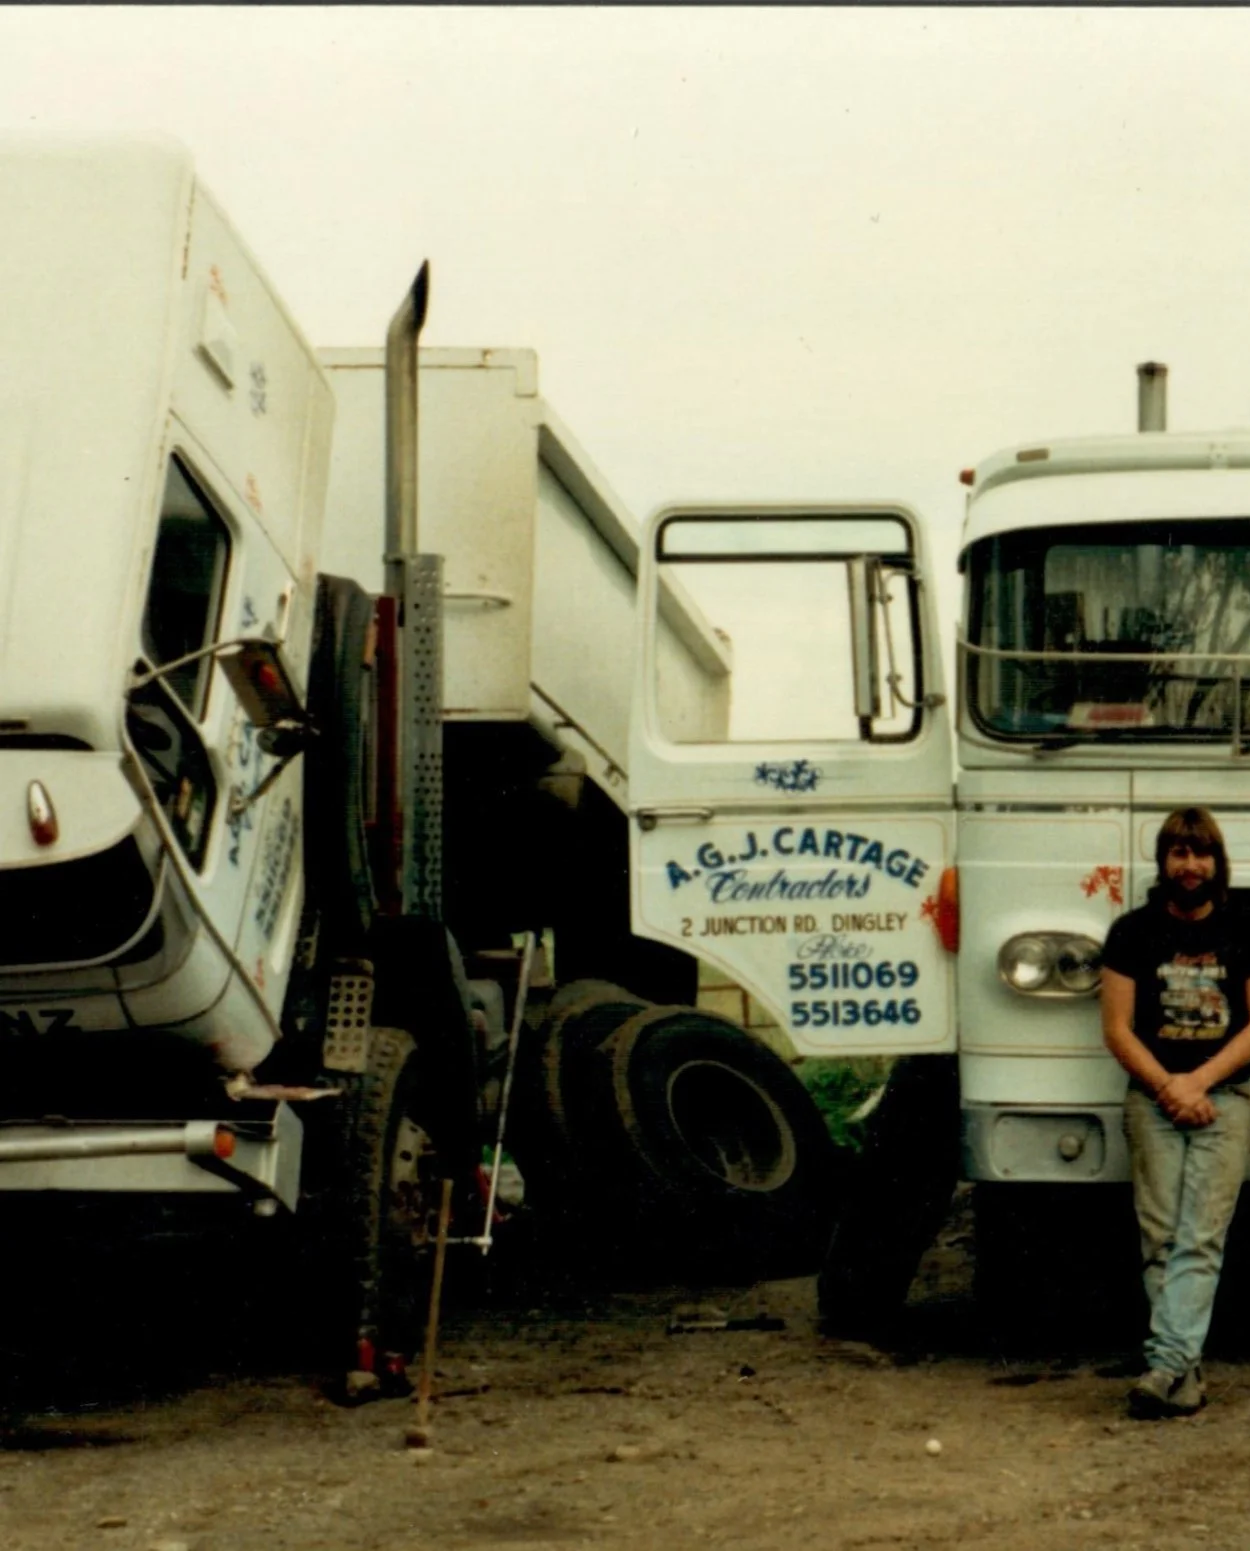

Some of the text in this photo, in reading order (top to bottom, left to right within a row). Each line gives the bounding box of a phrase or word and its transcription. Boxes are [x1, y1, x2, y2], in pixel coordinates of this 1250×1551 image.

[773, 827, 930, 888] CARTAGE
[706, 867, 871, 904] Contractors
[681, 918, 693, 937] 2
[700, 915, 787, 936] JUNCTION
[832, 912, 907, 932] DINGLEY
[788, 961, 918, 990] 5511069
[791, 998, 921, 1027] 5513646
